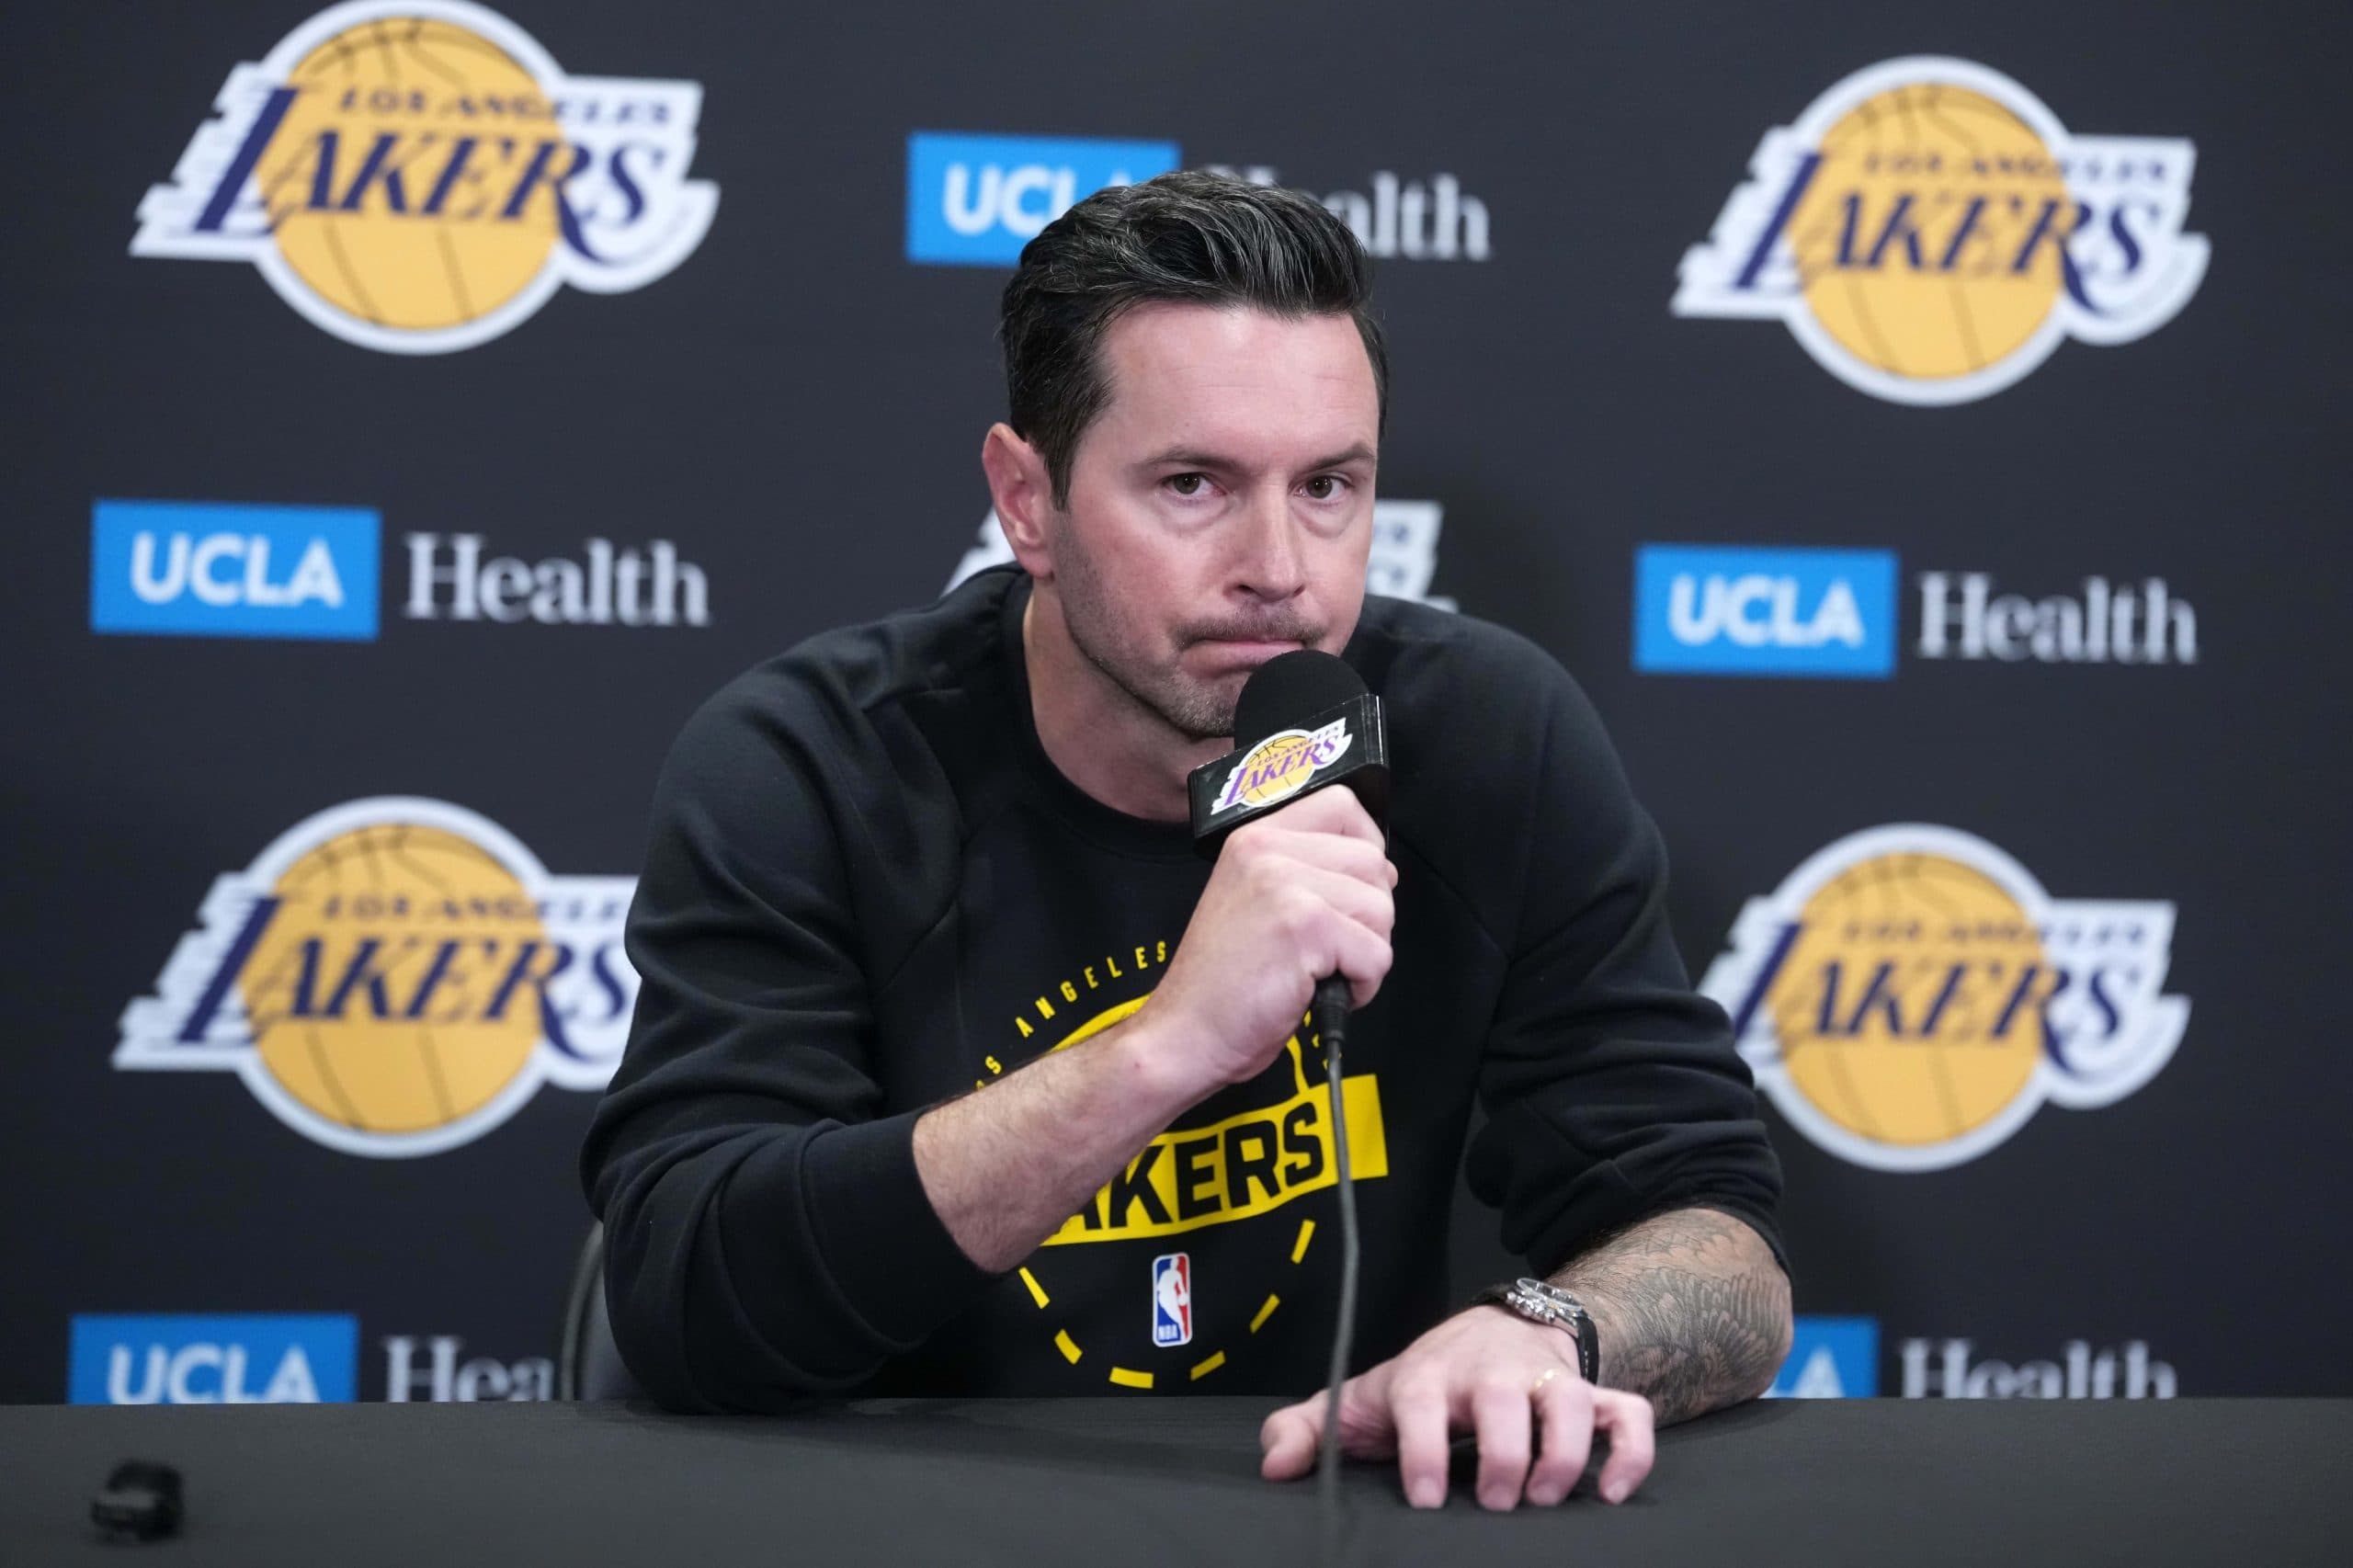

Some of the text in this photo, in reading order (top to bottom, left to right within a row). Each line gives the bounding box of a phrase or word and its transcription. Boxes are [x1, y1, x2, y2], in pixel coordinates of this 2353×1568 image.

[340, 85, 672, 126] LOS ANGELES
[189, 86, 671, 267] LAKERS
[1733, 153, 2162, 316] LAKERS
[130, 530, 710, 629] UCLA Health
[1667, 571, 2200, 665] UCLA Health
[1223, 735, 1339, 806] LAKERS
[1256, 752, 1279, 767] LOS
[426, 896, 627, 922] ANGELE
[174, 894, 632, 1063] LAKERS
[1015, 940, 1167, 1038] ANGELES
[1733, 922, 2143, 1083] LAKERS
[1070, 1102, 1324, 1235] KERS
[108, 1335, 553, 1403] UCLA Hea
[1899, 1337, 2178, 1399] Health
